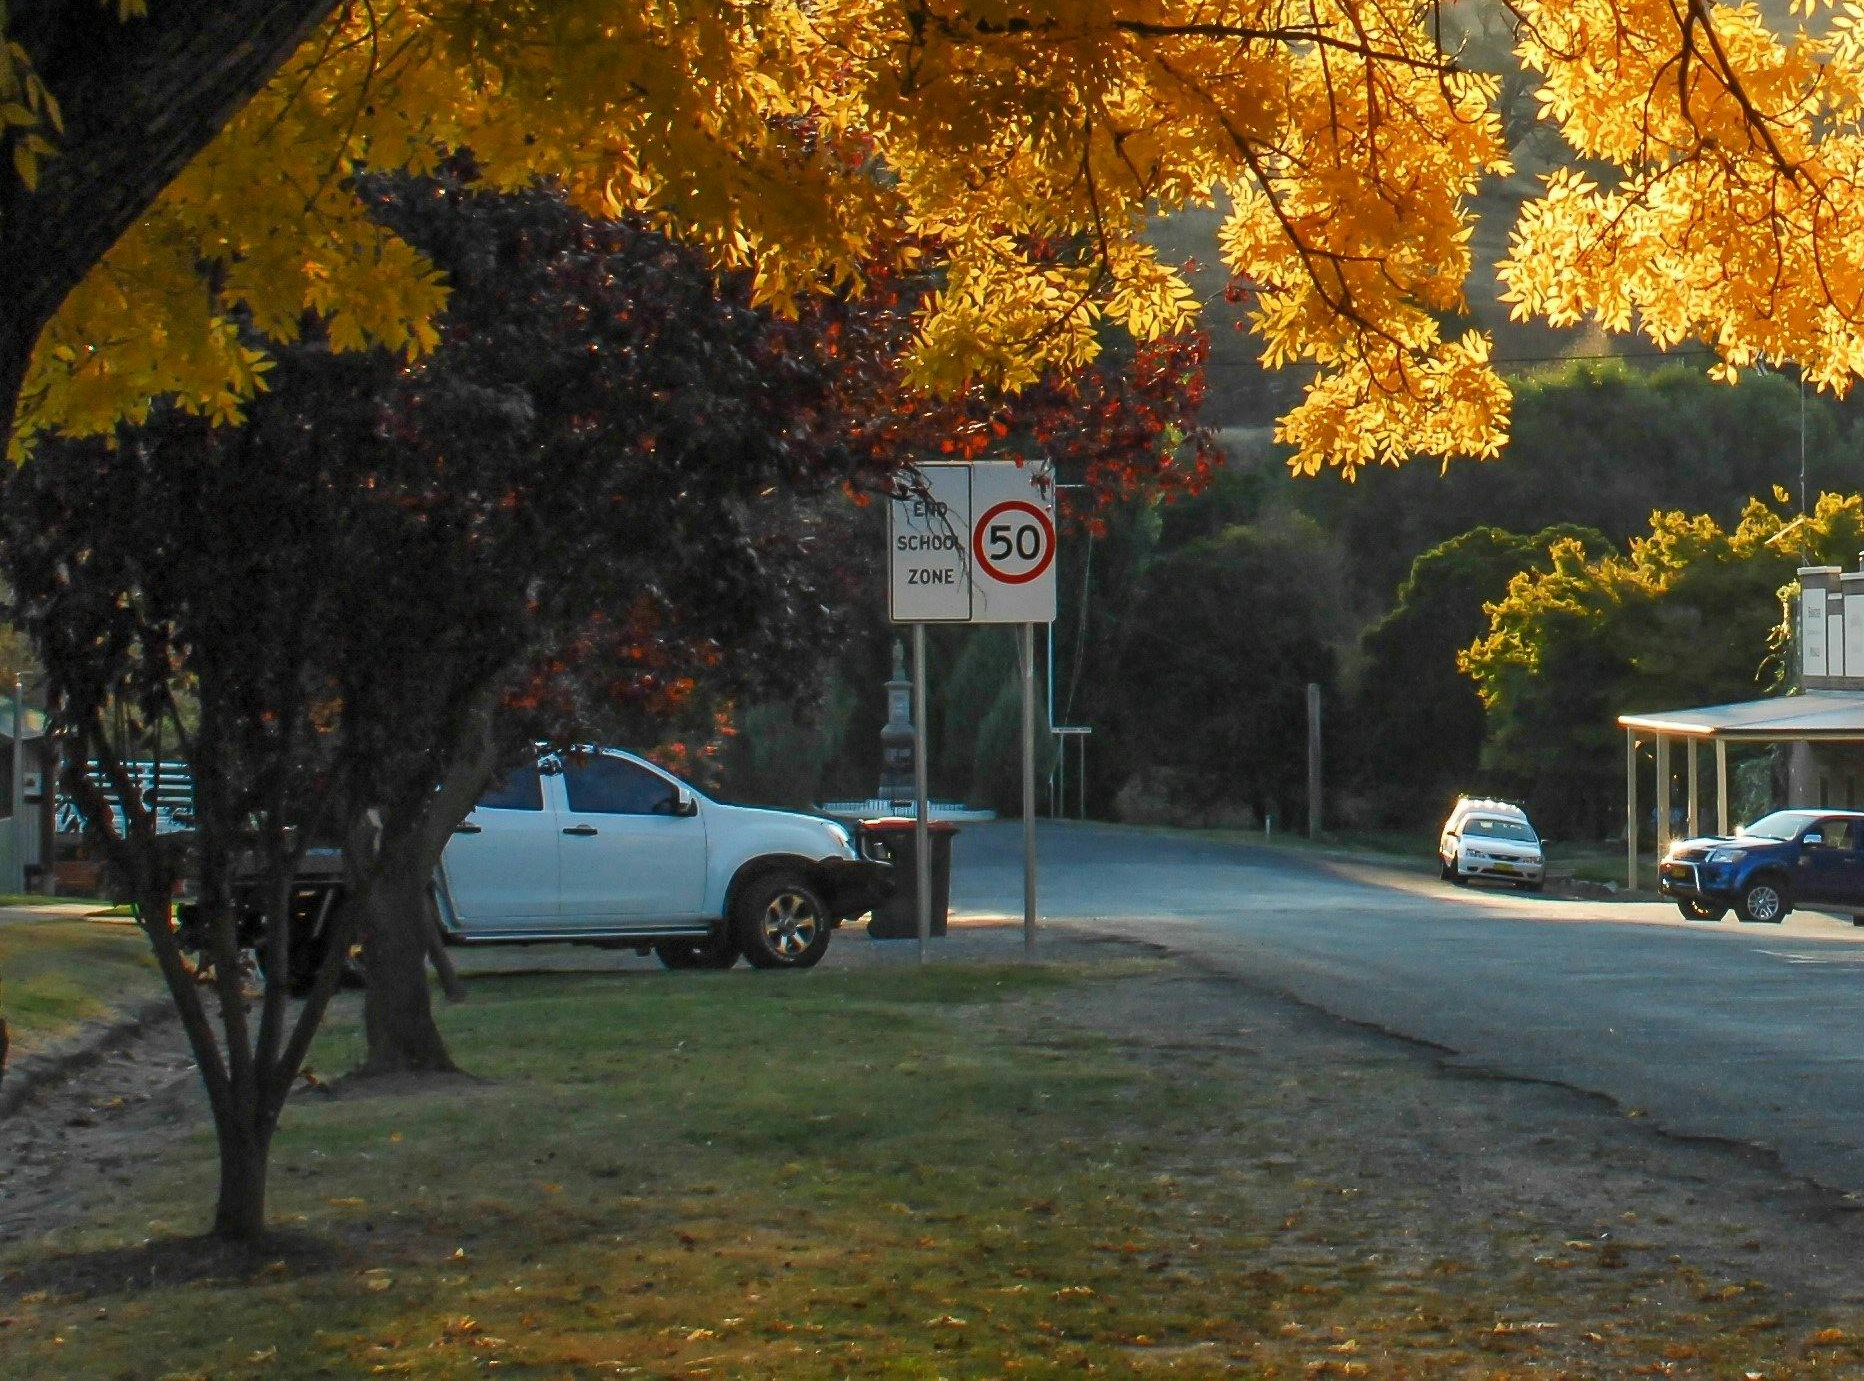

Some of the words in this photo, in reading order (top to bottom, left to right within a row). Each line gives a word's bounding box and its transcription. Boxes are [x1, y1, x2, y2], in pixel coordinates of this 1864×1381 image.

[897, 534, 964, 551] SCHOO
[989, 524, 1041, 561] 50
[907, 568, 955, 585] ZONE
